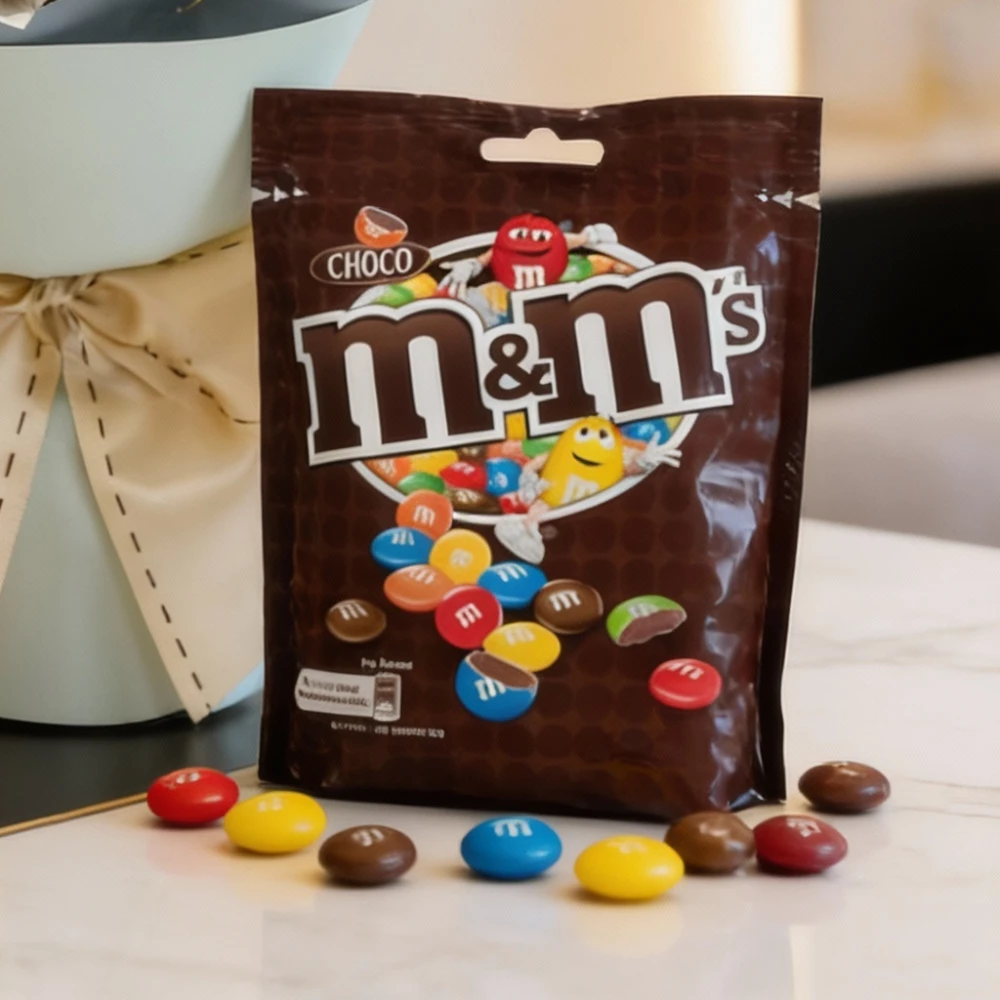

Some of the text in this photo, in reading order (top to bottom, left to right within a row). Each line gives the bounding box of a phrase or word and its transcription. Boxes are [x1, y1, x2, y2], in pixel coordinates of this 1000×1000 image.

[327, 248, 413, 280] CHOCO
[512, 265, 545, 290] m
[413, 505, 436, 527] m
[496, 562, 528, 582] m
[548, 589, 582, 611] m
[455, 603, 483, 628] m
[494, 818, 533, 838] m
